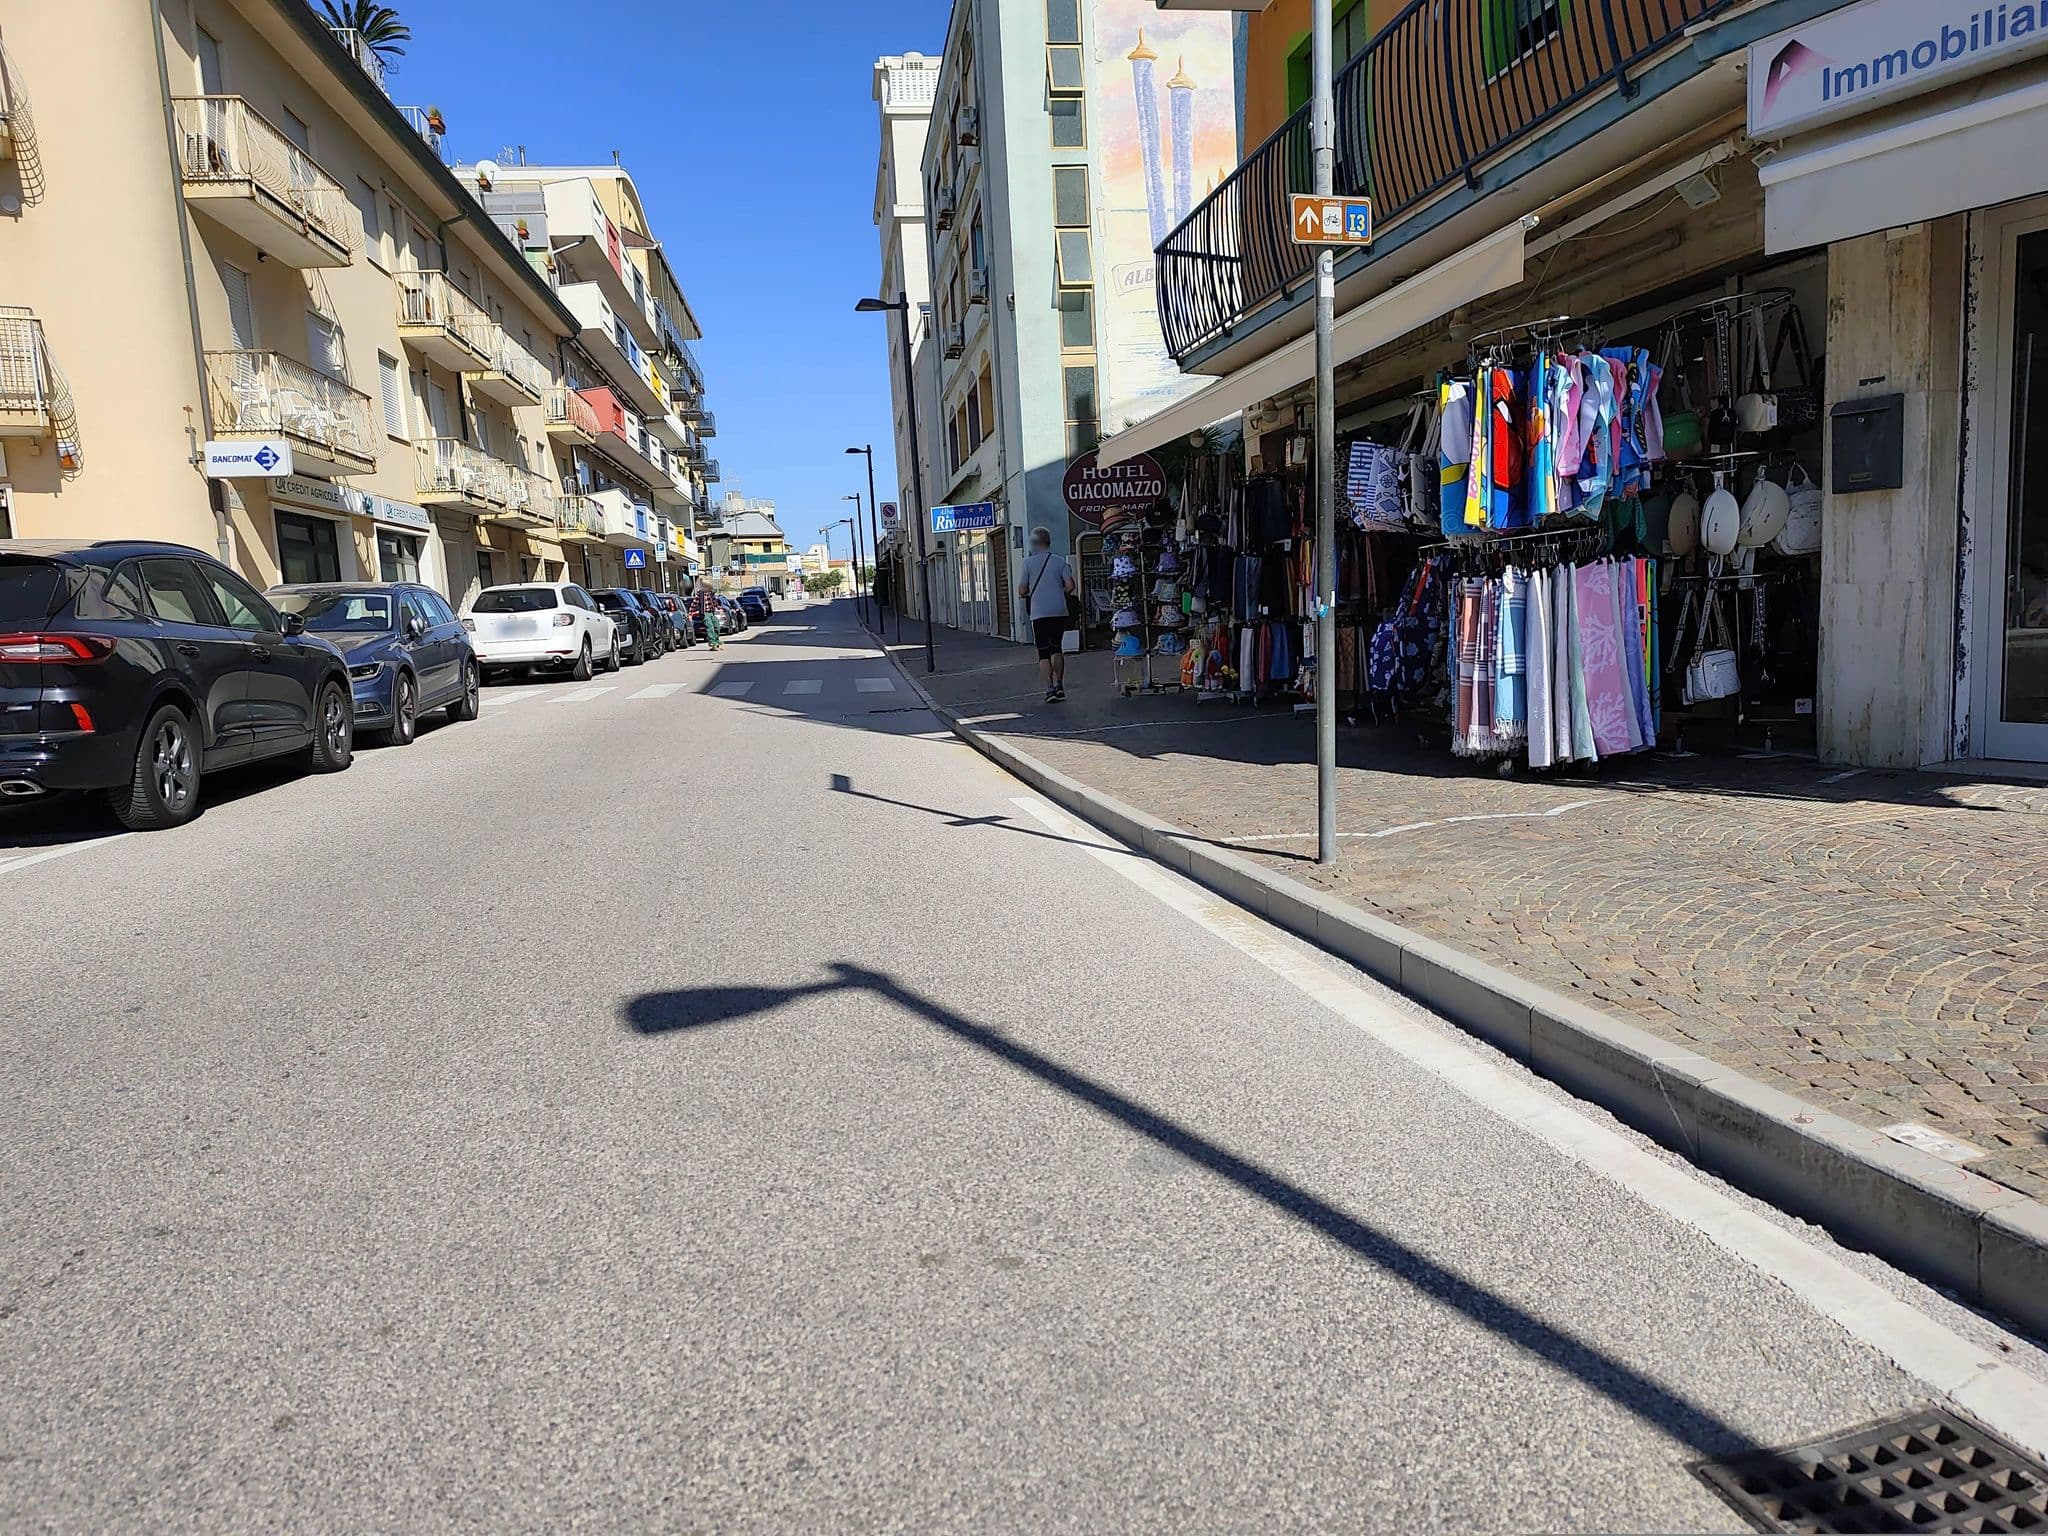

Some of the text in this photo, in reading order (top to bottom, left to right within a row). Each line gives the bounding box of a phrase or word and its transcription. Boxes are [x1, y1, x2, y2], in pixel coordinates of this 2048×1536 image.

[212, 455, 253, 464] BANCOMAT
[1082, 465, 1150, 480] HOTEL
[310, 487, 339, 503] AGRICOLE
[1068, 480, 1161, 500] GIACOMAZZO
[935, 515, 992, 530] Rivamare
